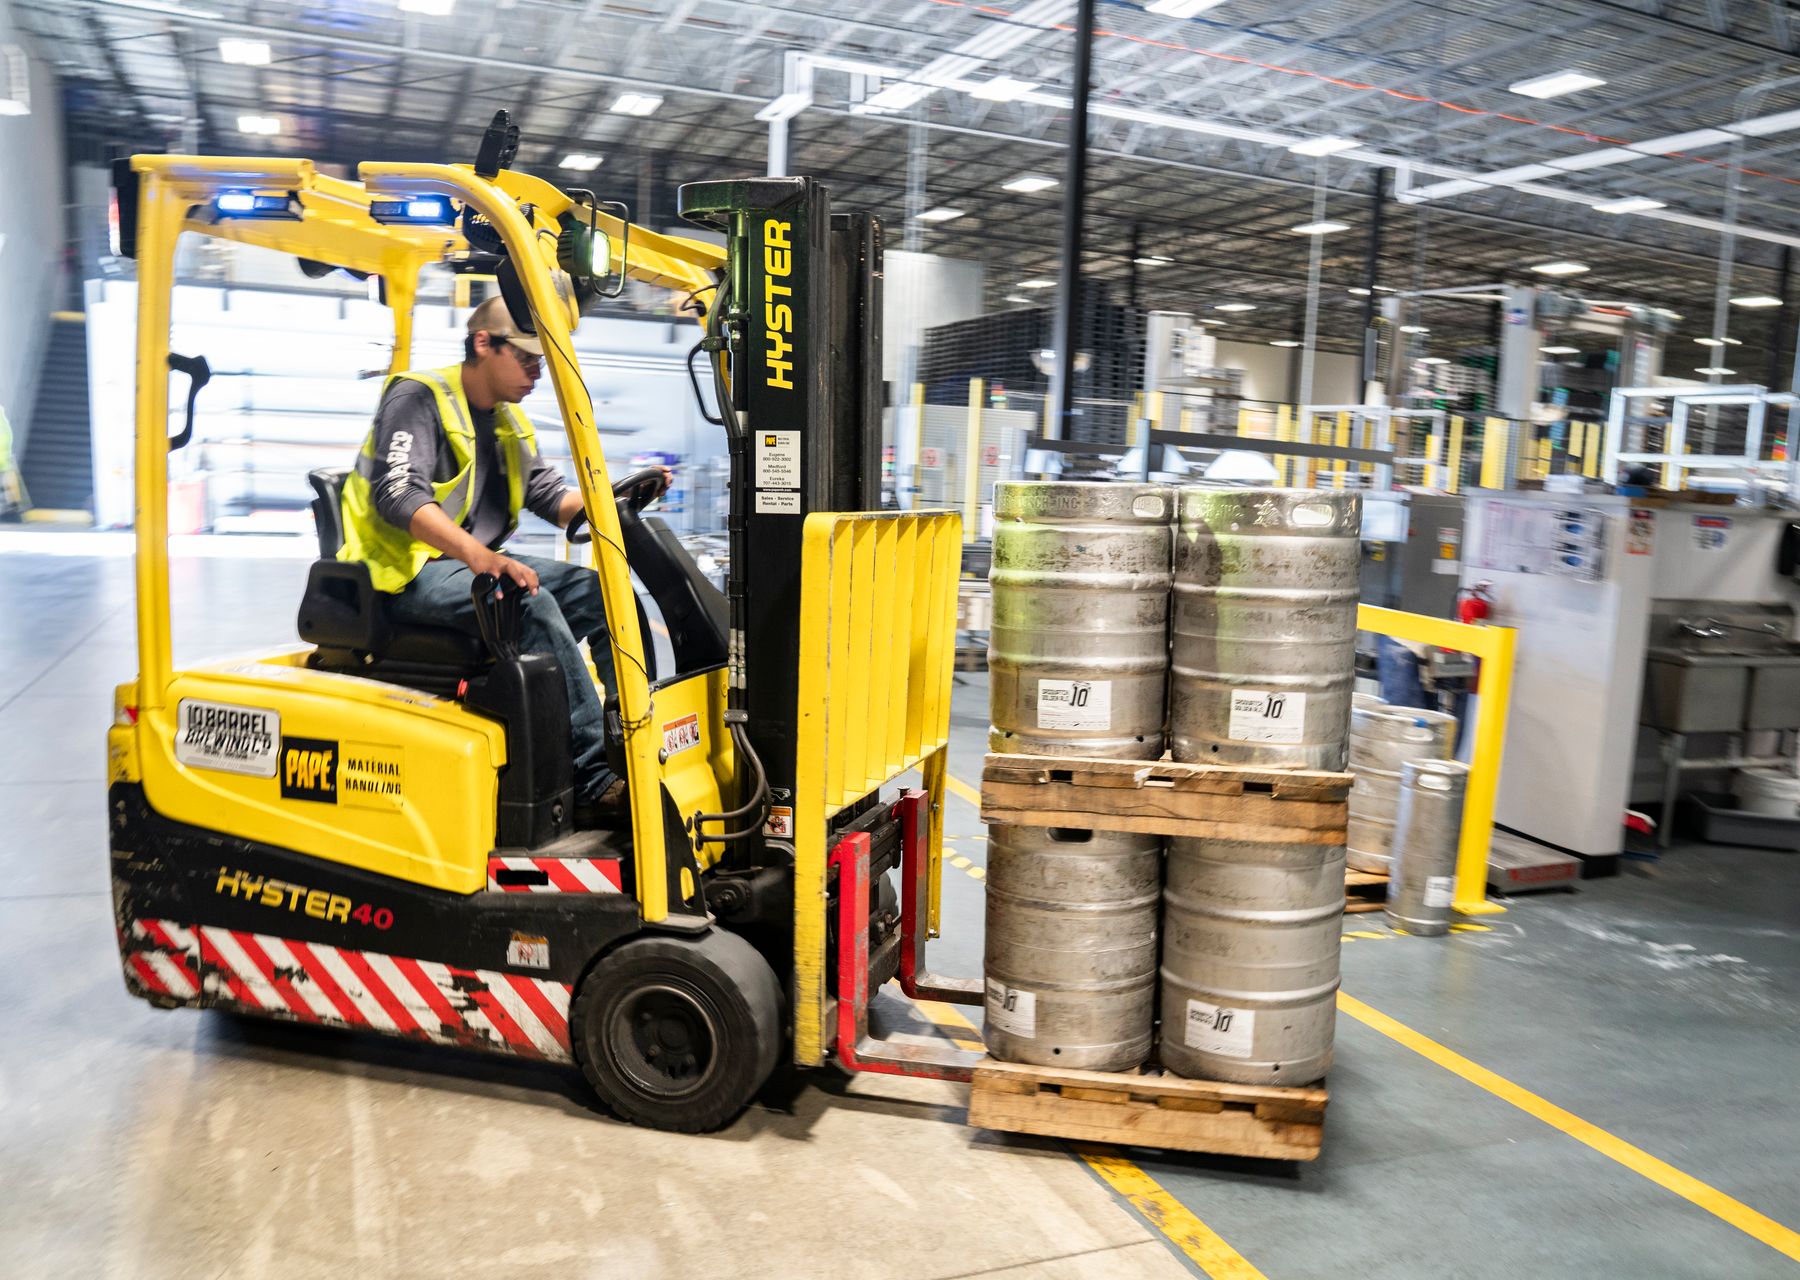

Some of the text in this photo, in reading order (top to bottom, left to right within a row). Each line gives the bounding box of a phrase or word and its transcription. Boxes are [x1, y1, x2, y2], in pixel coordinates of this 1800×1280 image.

[764, 219, 793, 390] HYSTER
[1069, 686, 1088, 707] 10
[1263, 697, 1283, 719] 10
[347, 759, 401, 776] MATERIAL
[345, 778, 402, 795] HANDLING
[215, 866, 394, 929] HYSTER 40
